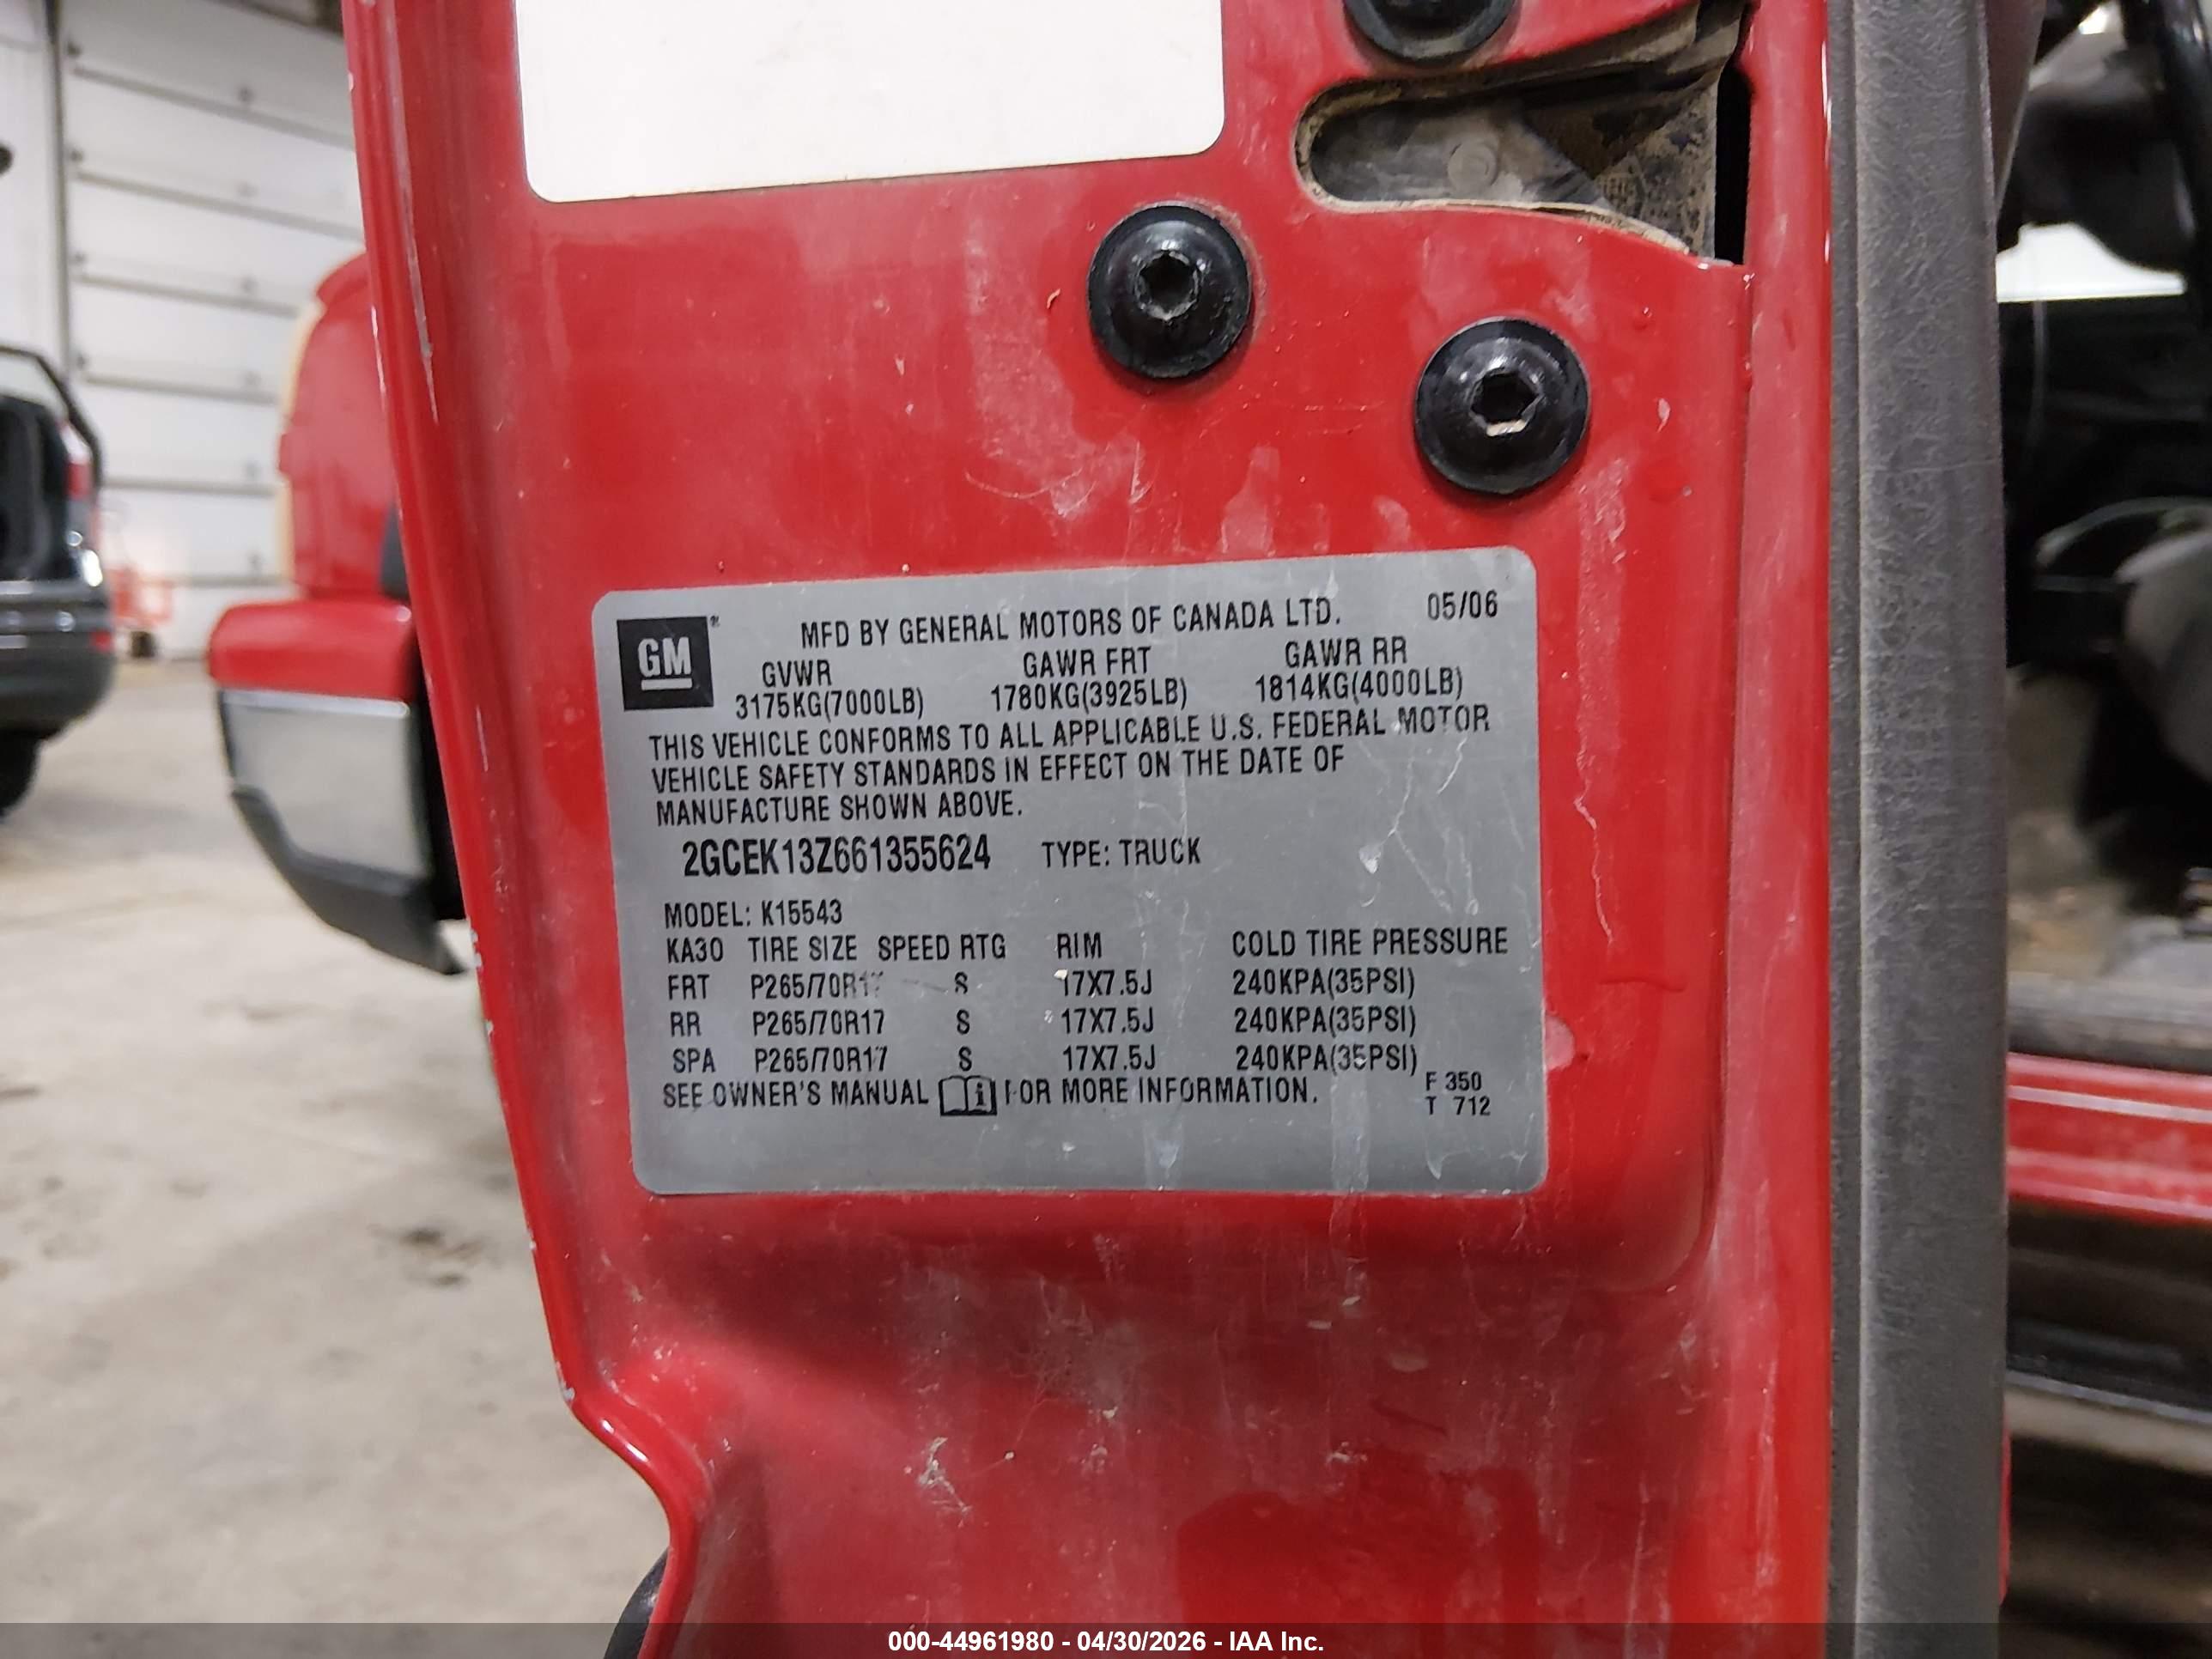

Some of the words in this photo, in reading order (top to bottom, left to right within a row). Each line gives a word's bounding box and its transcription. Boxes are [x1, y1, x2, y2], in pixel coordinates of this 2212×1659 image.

[1428, 589, 1498, 620] 05/06
[801, 621, 849, 649] MFD
[860, 618, 889, 646] BY
[900, 613, 1009, 645] GENERAL
[1020, 607, 1121, 638] MOTORS
[1132, 605, 1161, 634] OF
[1174, 599, 1274, 632] CANADA
[1286, 597, 1340, 627] LTD.
[638, 636, 691, 678] GM
[1024, 649, 1096, 678] GAWR
[1106, 646, 1152, 675] FRT
[1285, 637, 1362, 668] GAWR
[1373, 635, 1407, 665] RR
[762, 659, 832, 688] GVWR
[1255, 666, 1462, 705] 1814KG(4000LB)
[736, 687, 923, 722] 3175KG(7000LB)
[991, 680, 1187, 714] 1780KG(3925LB)
[648, 734, 704, 761] THIS
[712, 730, 809, 758] VEHICLE
[819, 725, 951, 755] CONFORMS
[959, 723, 988, 750] TO
[1000, 721, 1043, 749] ALL
[1053, 714, 1200, 747] APPLICABLE
[1211, 713, 1261, 741] U.S.
[1273, 708, 1386, 739] FEDERAL
[1398, 703, 1490, 734] MOTOR
[652, 765, 749, 793] VEHICLE
[759, 762, 845, 790] SAFETY
[854, 757, 995, 787] STANDARDS
[1006, 756, 1028, 782] IN
[1041, 751, 1127, 781] EFFECT
[1139, 750, 1170, 778] ON
[1182, 749, 1229, 777] THE
[1241, 745, 1303, 775] DATE
[1314, 744, 1344, 772] OF
[657, 795, 830, 827] MANUFACTURE
[841, 793, 927, 820] SHOWN
[939, 790, 1022, 817] ABOVE.
[683, 833, 991, 878] 2GCEK13Z661355624
[1041, 840, 1109, 868] TYPE:
[1119, 836, 1200, 866] TRUCK
[665, 902, 750, 929] MODEL:
[762, 898, 842, 927] K15543
[666, 937, 723, 963] KA30
[748, 936, 799, 963] TIRE
[809, 934, 857, 961] SIZE
[878, 934, 950, 962] SPEED
[961, 933, 1006, 960] RTG
[1057, 932, 1102, 959] RIM
[1232, 930, 1296, 957] COLD
[1306, 928, 1361, 957] TIRE
[1373, 927, 1508, 955] PRESSURE
[668, 974, 709, 1000] FRT
[955, 971, 968, 994] S
[1064, 969, 1152, 996] 17X7.5J
[1233, 967, 1414, 1000] 240KPA(35PSI)
[671, 1012, 701, 1037] RR
[753, 1009, 884, 1036] P265/70R17
[957, 1009, 969, 1036] S
[1061, 1006, 1153, 1034] 17X7.5J
[1234, 1005, 1416, 1038] 240KPA(35PSI)
[673, 1048, 715, 1073] SPA
[755, 1046, 887, 1073] P265/70R17
[958, 1046, 972, 1072] S
[1063, 1044, 1155, 1072] 17X7.5J
[1237, 1044, 1417, 1077] 240KPA(35PSI)
[663, 1083, 702, 1109] SEE
[713, 1080, 820, 1107] OWNER'S
[831, 1079, 929, 1106] MANUAL
[1062, 1077, 1127, 1104] MORE
[1139, 1076, 1317, 1103] INFORMATION.
[1426, 1072, 1437, 1091] F
[1445, 1071, 1481, 1091] 350
[1425, 1096, 1437, 1115] T
[1453, 1096, 1491, 1115] 712
